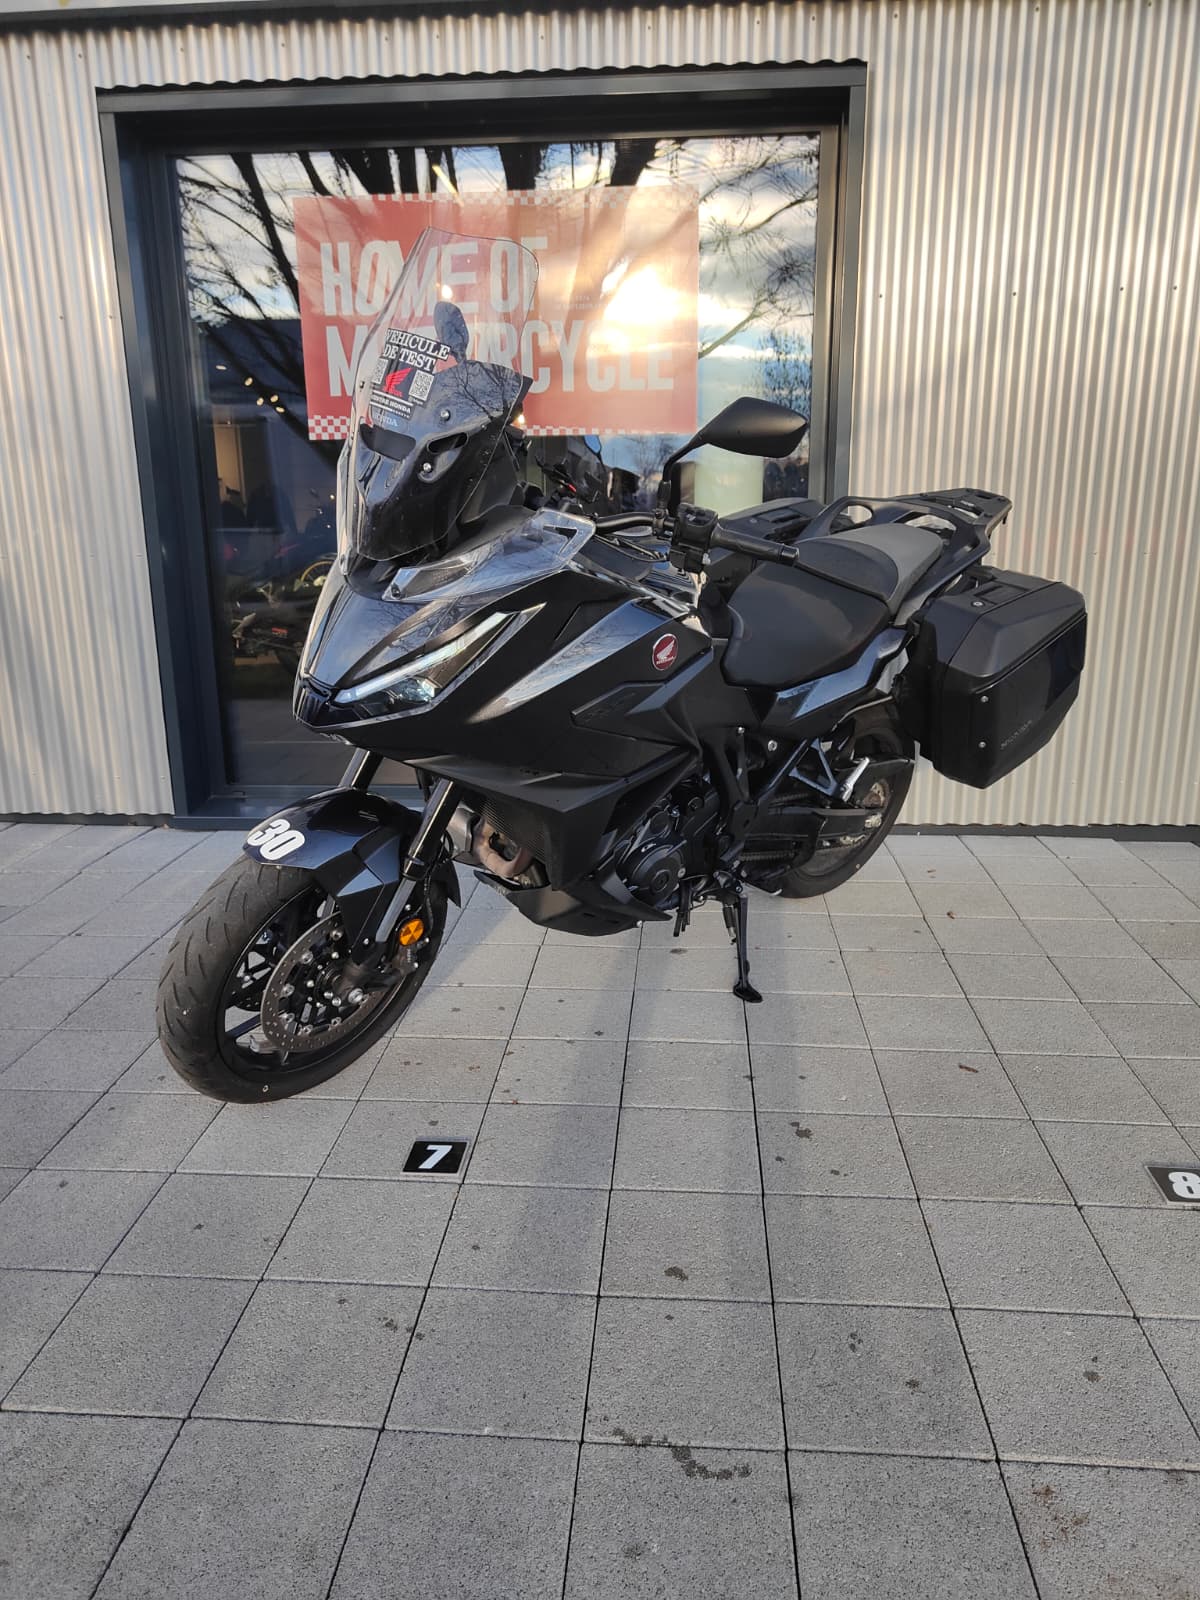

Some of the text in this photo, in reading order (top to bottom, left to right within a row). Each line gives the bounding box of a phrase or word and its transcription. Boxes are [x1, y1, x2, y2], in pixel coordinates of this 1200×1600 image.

[320, 236, 548, 318] HOME OF
[325, 319, 674, 398] MRCYCLE
[383, 344, 436, 371] DE TEST
[386, 329, 450, 359] VEHICULE
[247, 819, 305, 860] 30
[418, 1145, 453, 1169] 7
[1168, 1171, 1200, 1199] 8
